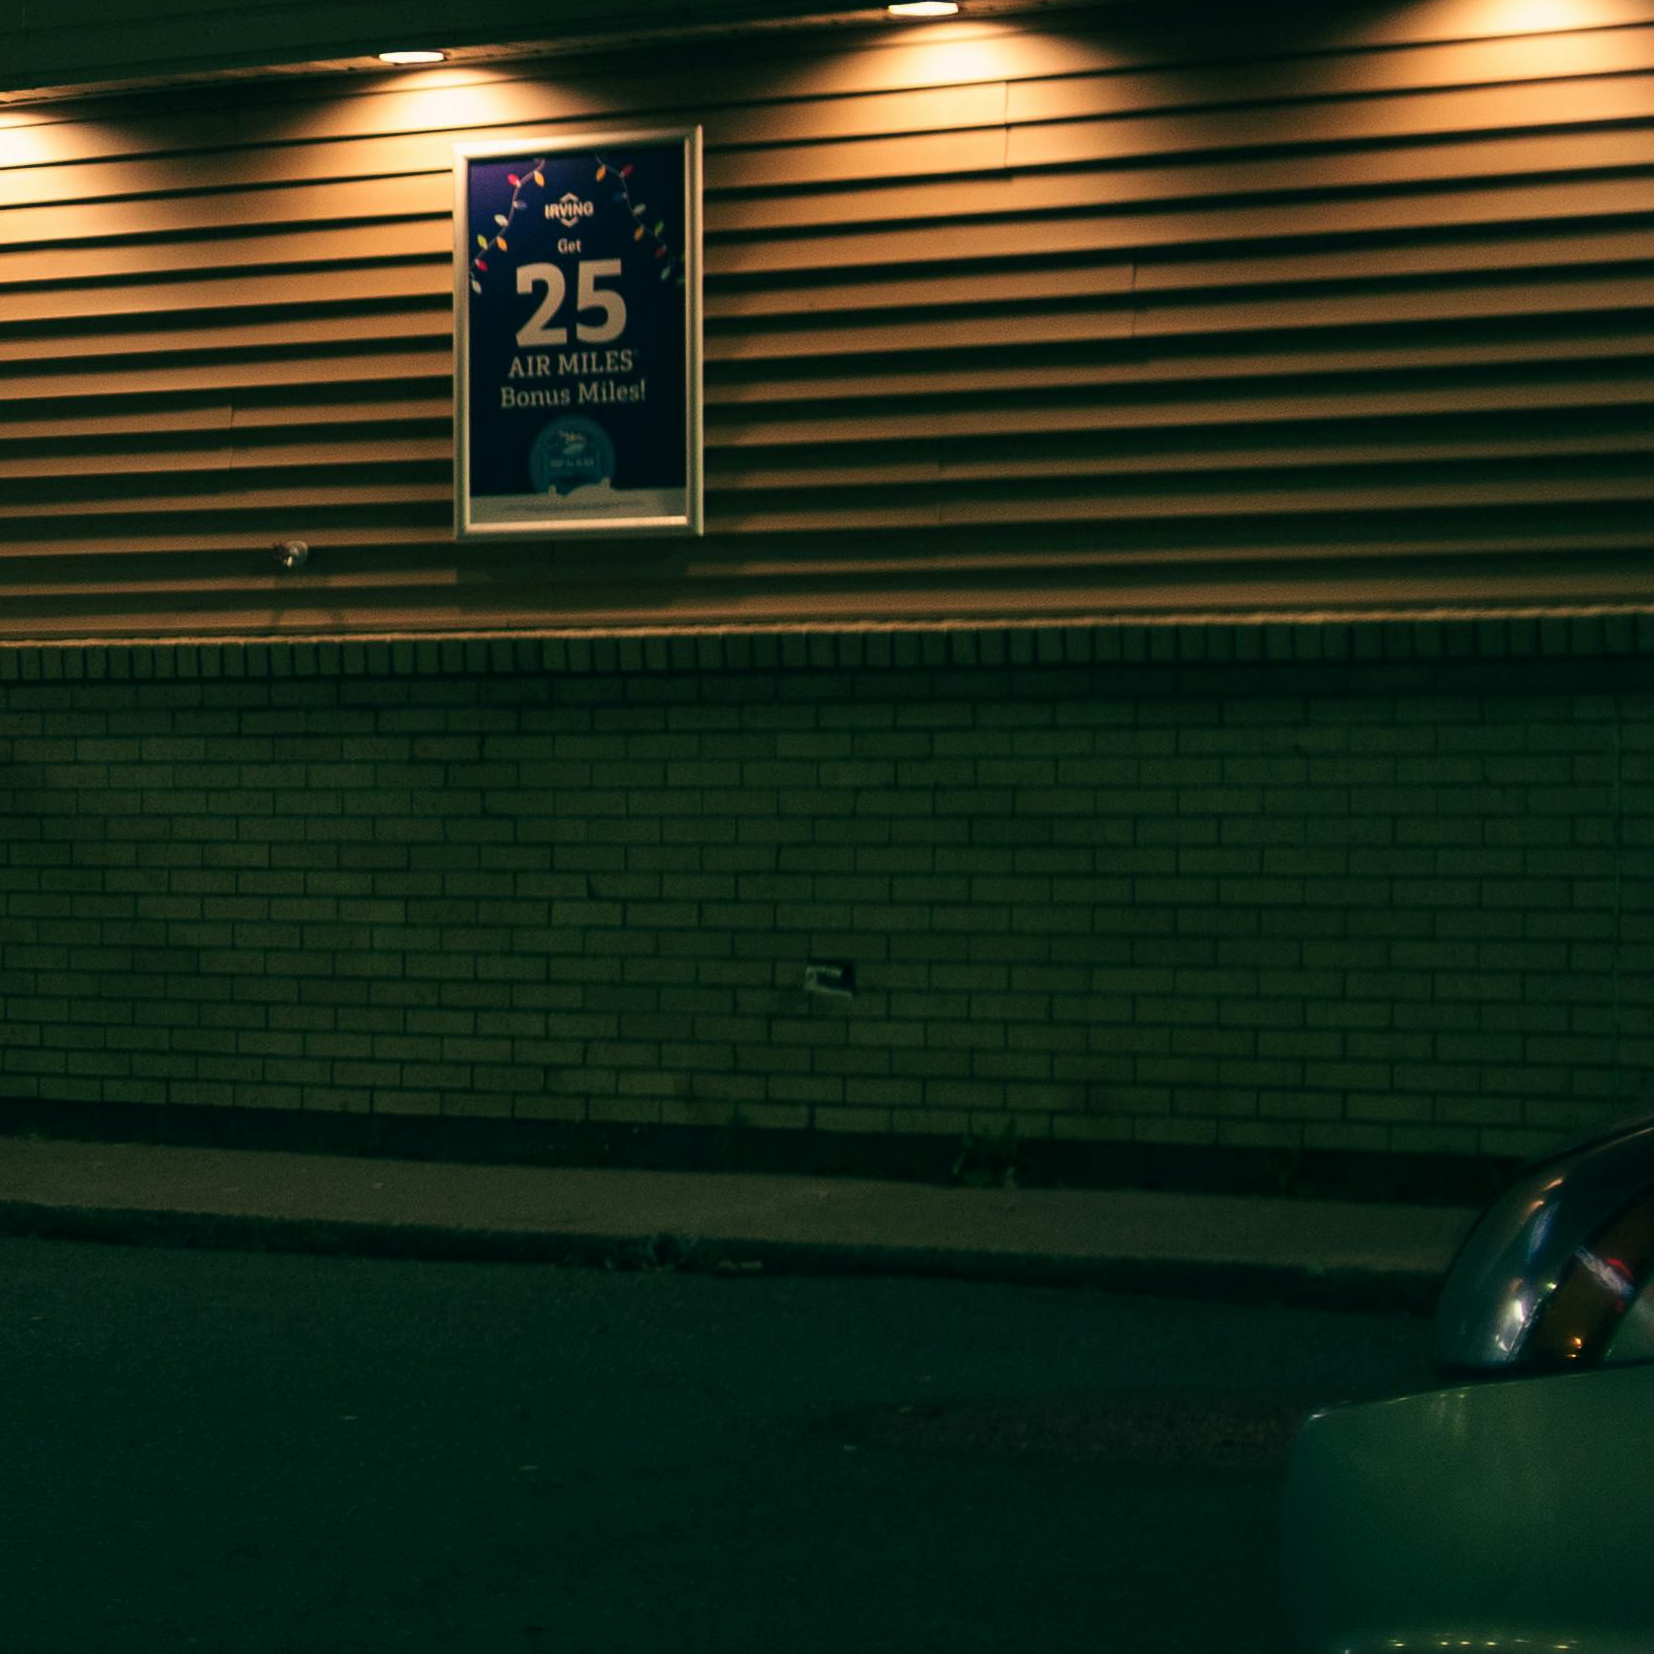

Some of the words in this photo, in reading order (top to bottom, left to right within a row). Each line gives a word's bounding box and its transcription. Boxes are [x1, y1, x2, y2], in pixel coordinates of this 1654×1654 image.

[544, 201, 594, 219] IRVING
[557, 237, 582, 254] Get
[515, 257, 628, 348] 25
[508, 354, 551, 379] AIR
[557, 349, 633, 375] MILES
[500, 386, 571, 409] Bonus
[578, 378, 646, 405] Miles!
